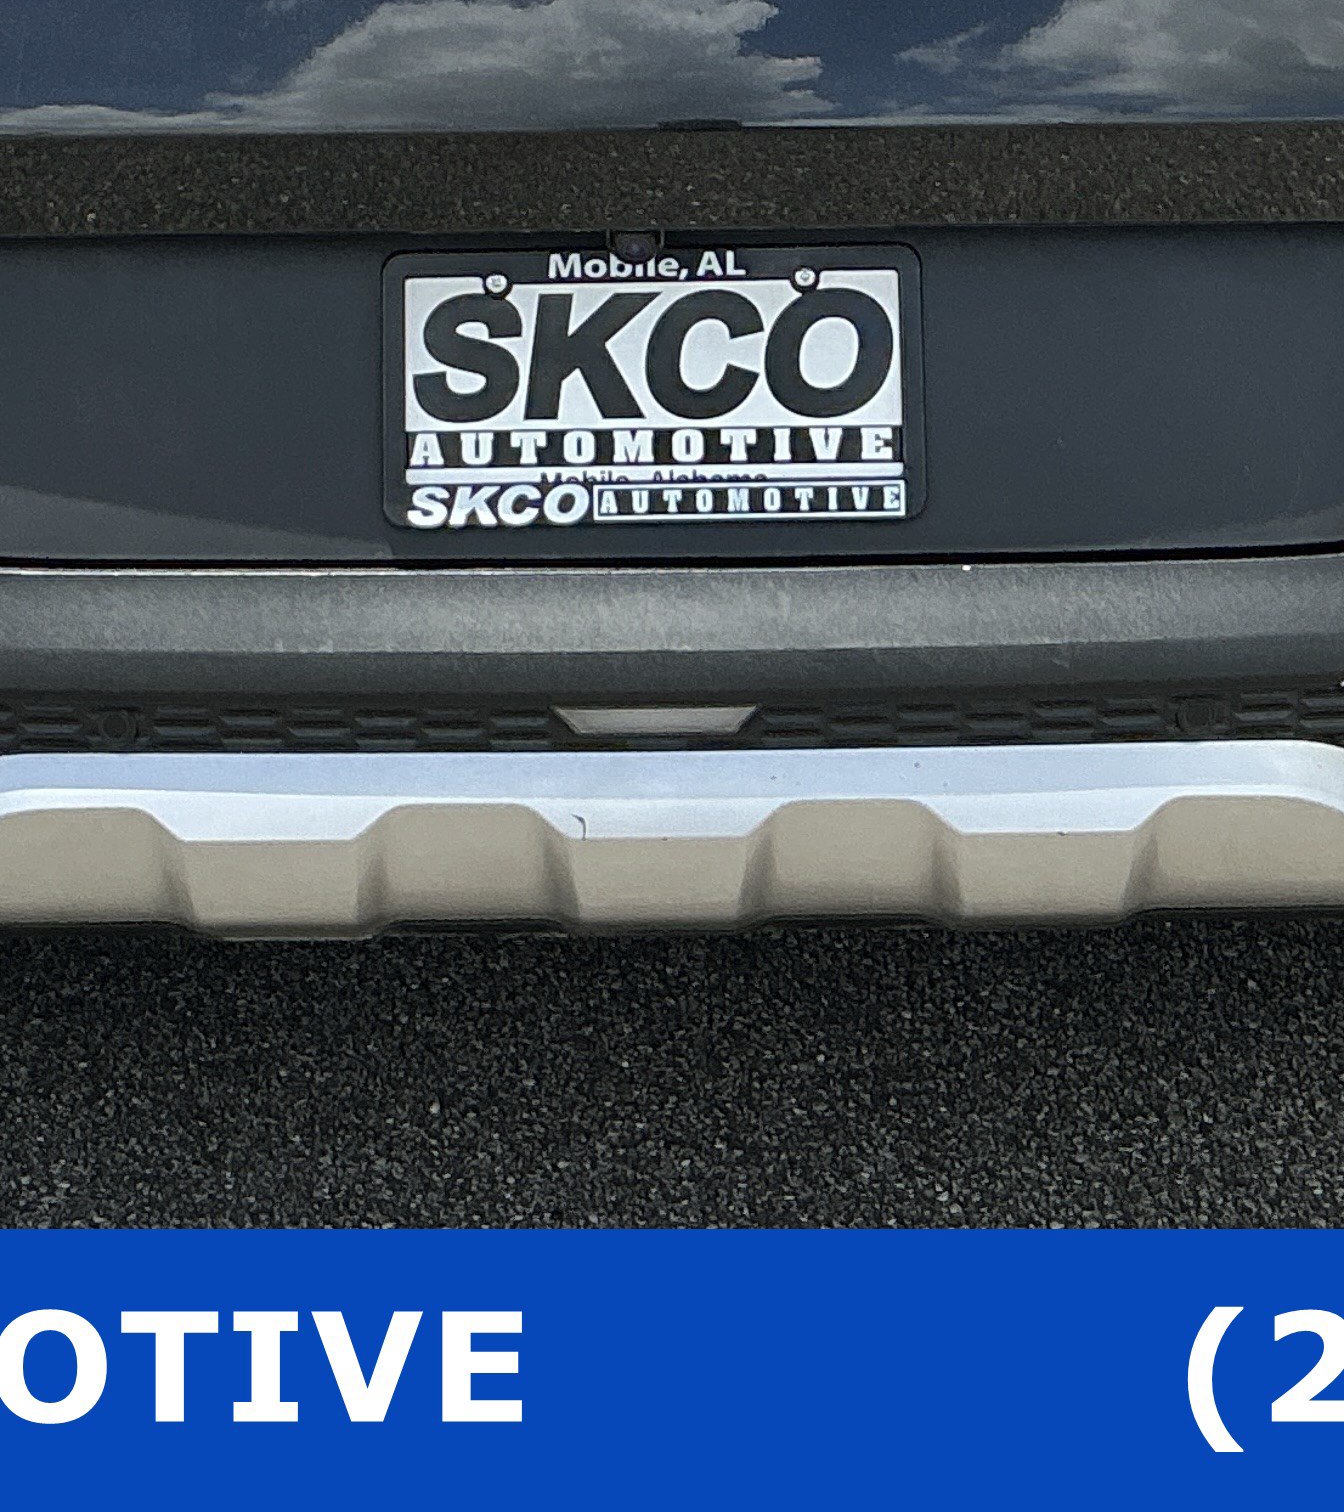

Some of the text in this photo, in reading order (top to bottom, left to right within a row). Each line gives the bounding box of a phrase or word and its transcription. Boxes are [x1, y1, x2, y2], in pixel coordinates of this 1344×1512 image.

[548, 250, 747, 280] Mobile, AL
[412, 288, 894, 422] SKCO
[410, 428, 893, 467] AUTOMOTIVE
[407, 484, 588, 528] SKCO
[601, 487, 900, 514] AUTOMOTIVE
